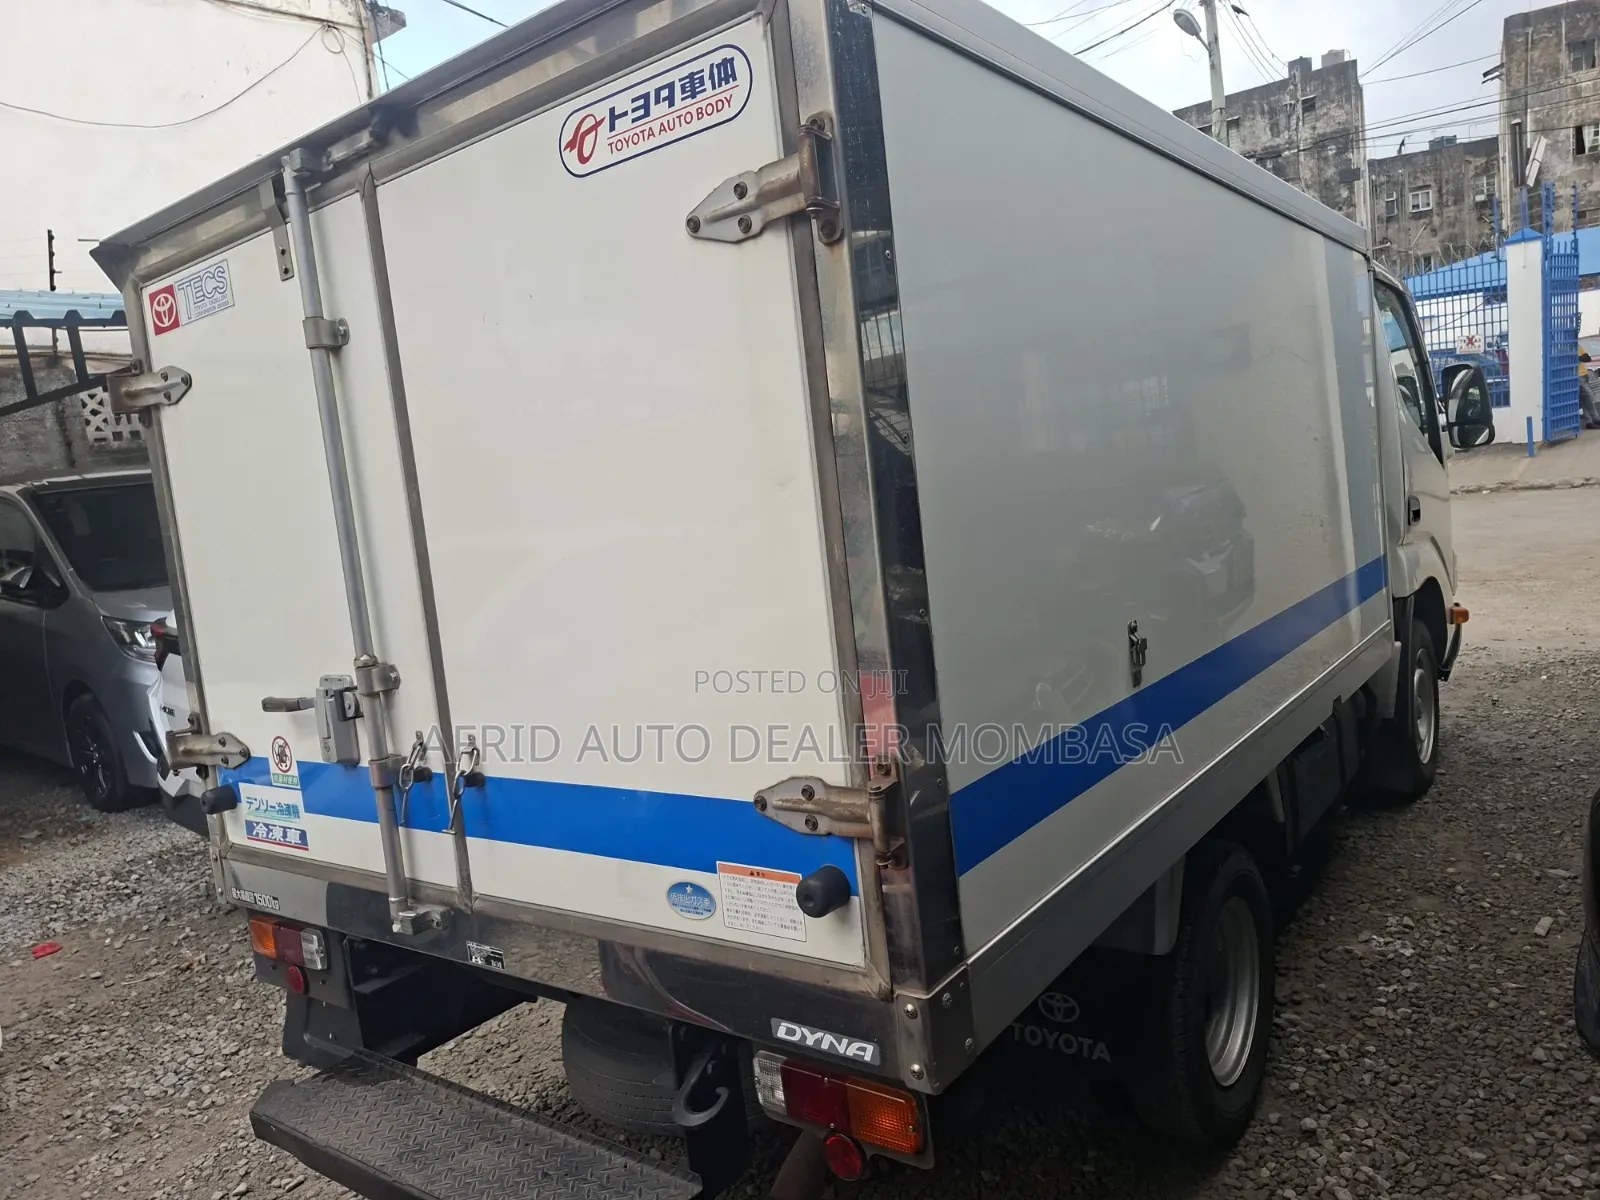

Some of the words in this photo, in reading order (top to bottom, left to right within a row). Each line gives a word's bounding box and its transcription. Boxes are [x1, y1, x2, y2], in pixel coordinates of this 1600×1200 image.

[608, 56, 737, 133] トヨタ車体
[608, 126, 655, 155] TOYOTA
[658, 111, 693, 136] AUTO
[696, 94, 733, 121] BODY
[177, 265, 228, 320] TECS
[252, 822, 302, 844] 冷凍車
[254, 892, 280, 910] 1500kg
[777, 1022, 874, 1061] DYNA
[1011, 1022, 1112, 1064] TOYOTA
